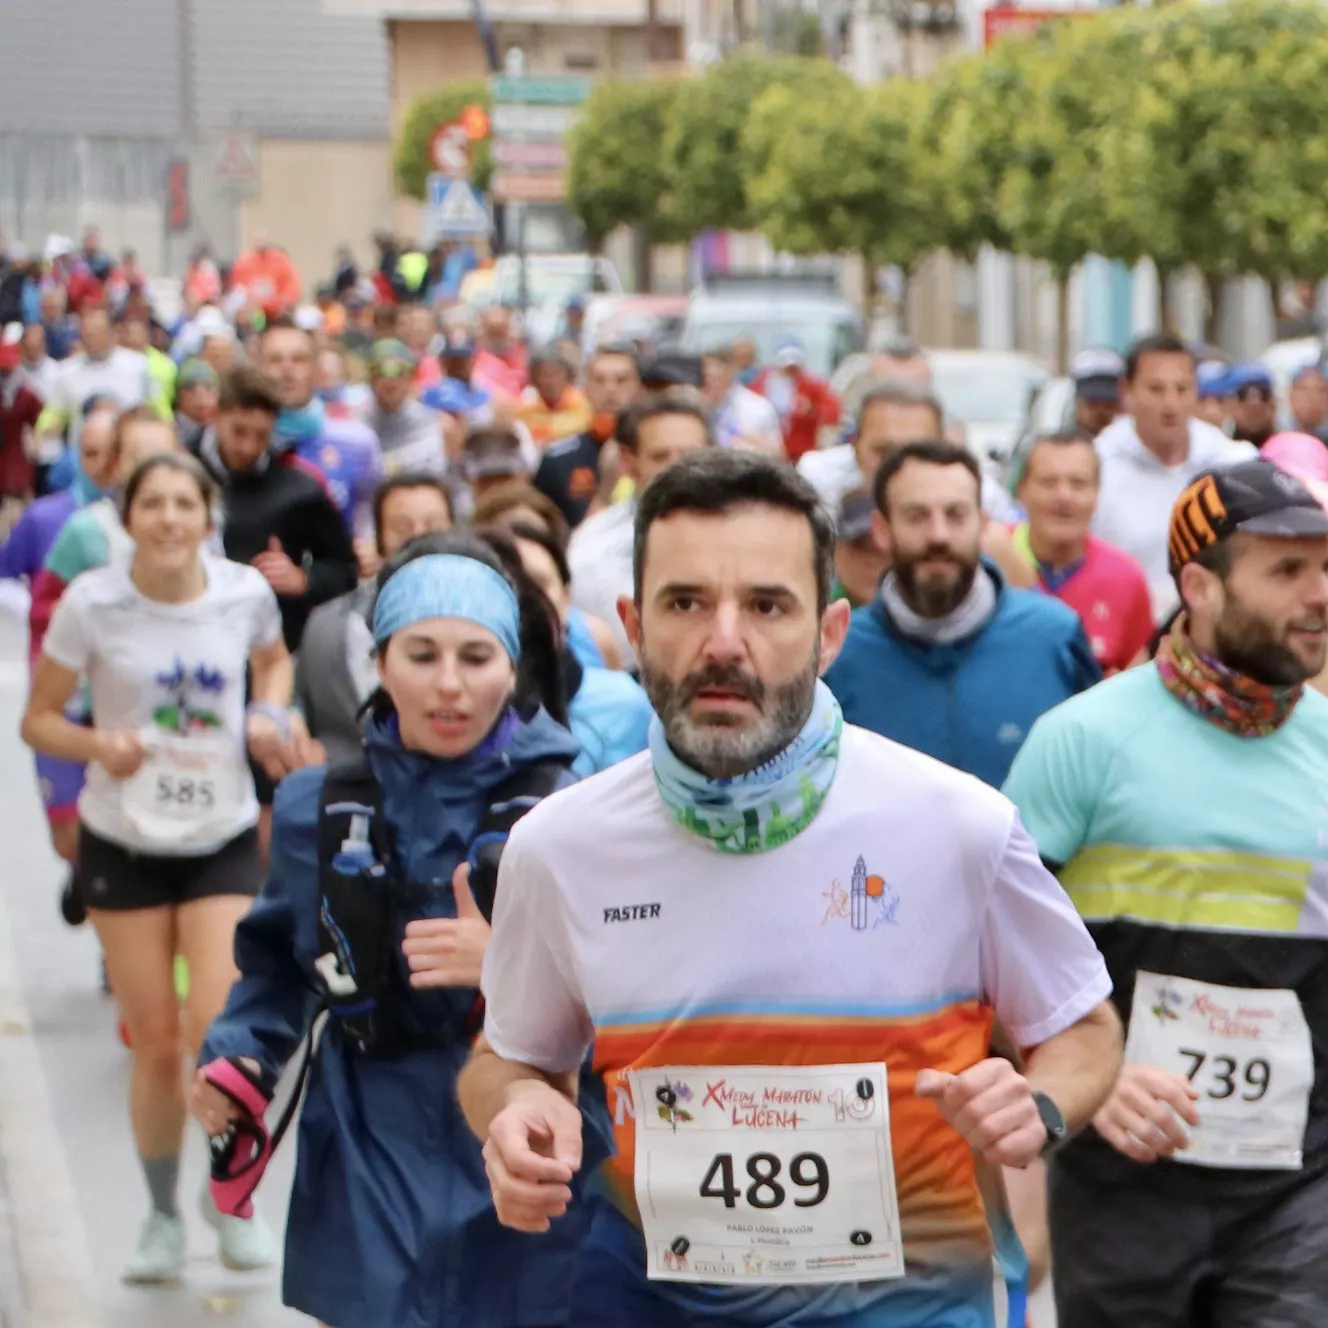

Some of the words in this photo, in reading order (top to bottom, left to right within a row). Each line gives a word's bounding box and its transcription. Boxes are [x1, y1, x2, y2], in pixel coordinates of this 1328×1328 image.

[156, 776, 215, 807] 585
[603, 903, 661, 924] FASTER
[1177, 1044, 1271, 1101] 739
[732, 1106, 802, 1129] LUCENA
[700, 1151, 829, 1208] 489
